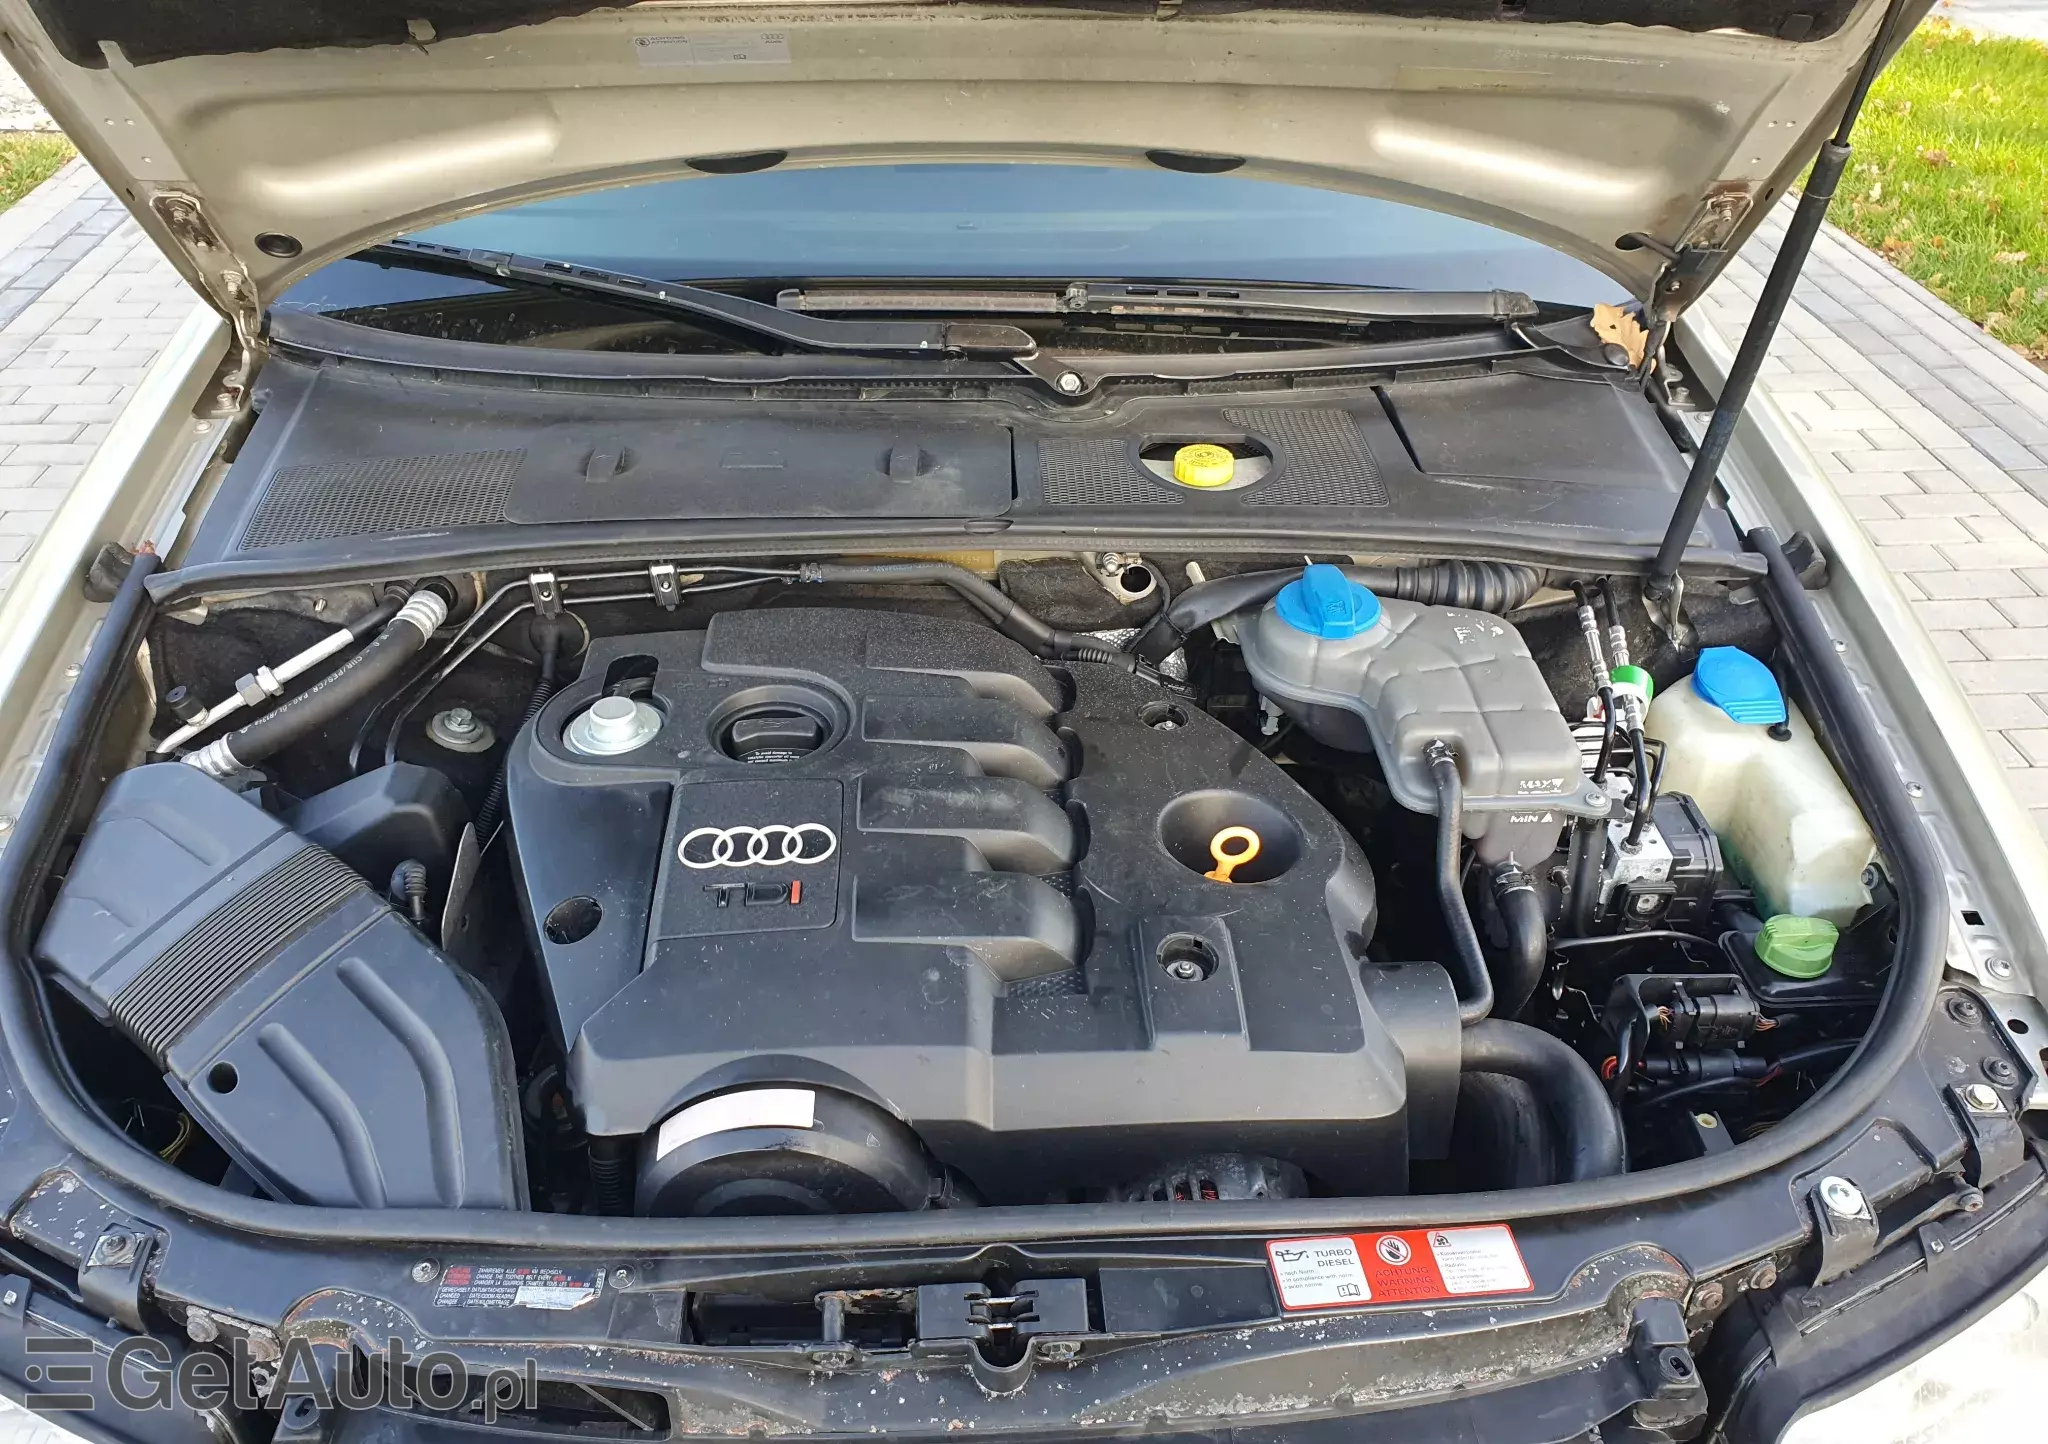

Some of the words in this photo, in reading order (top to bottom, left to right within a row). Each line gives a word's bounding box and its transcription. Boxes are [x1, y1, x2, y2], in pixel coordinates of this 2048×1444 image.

[1510, 815, 1538, 823] MIN
[702, 880, 802, 908] TDI
[1314, 1248, 1352, 1257] TURBO
[1317, 1258, 1355, 1267] DIESEL
[1375, 1267, 1429, 1278] ACHTUNG
[1377, 1276, 1433, 1287] WARNING
[1378, 1285, 1440, 1297] ATTENTION
